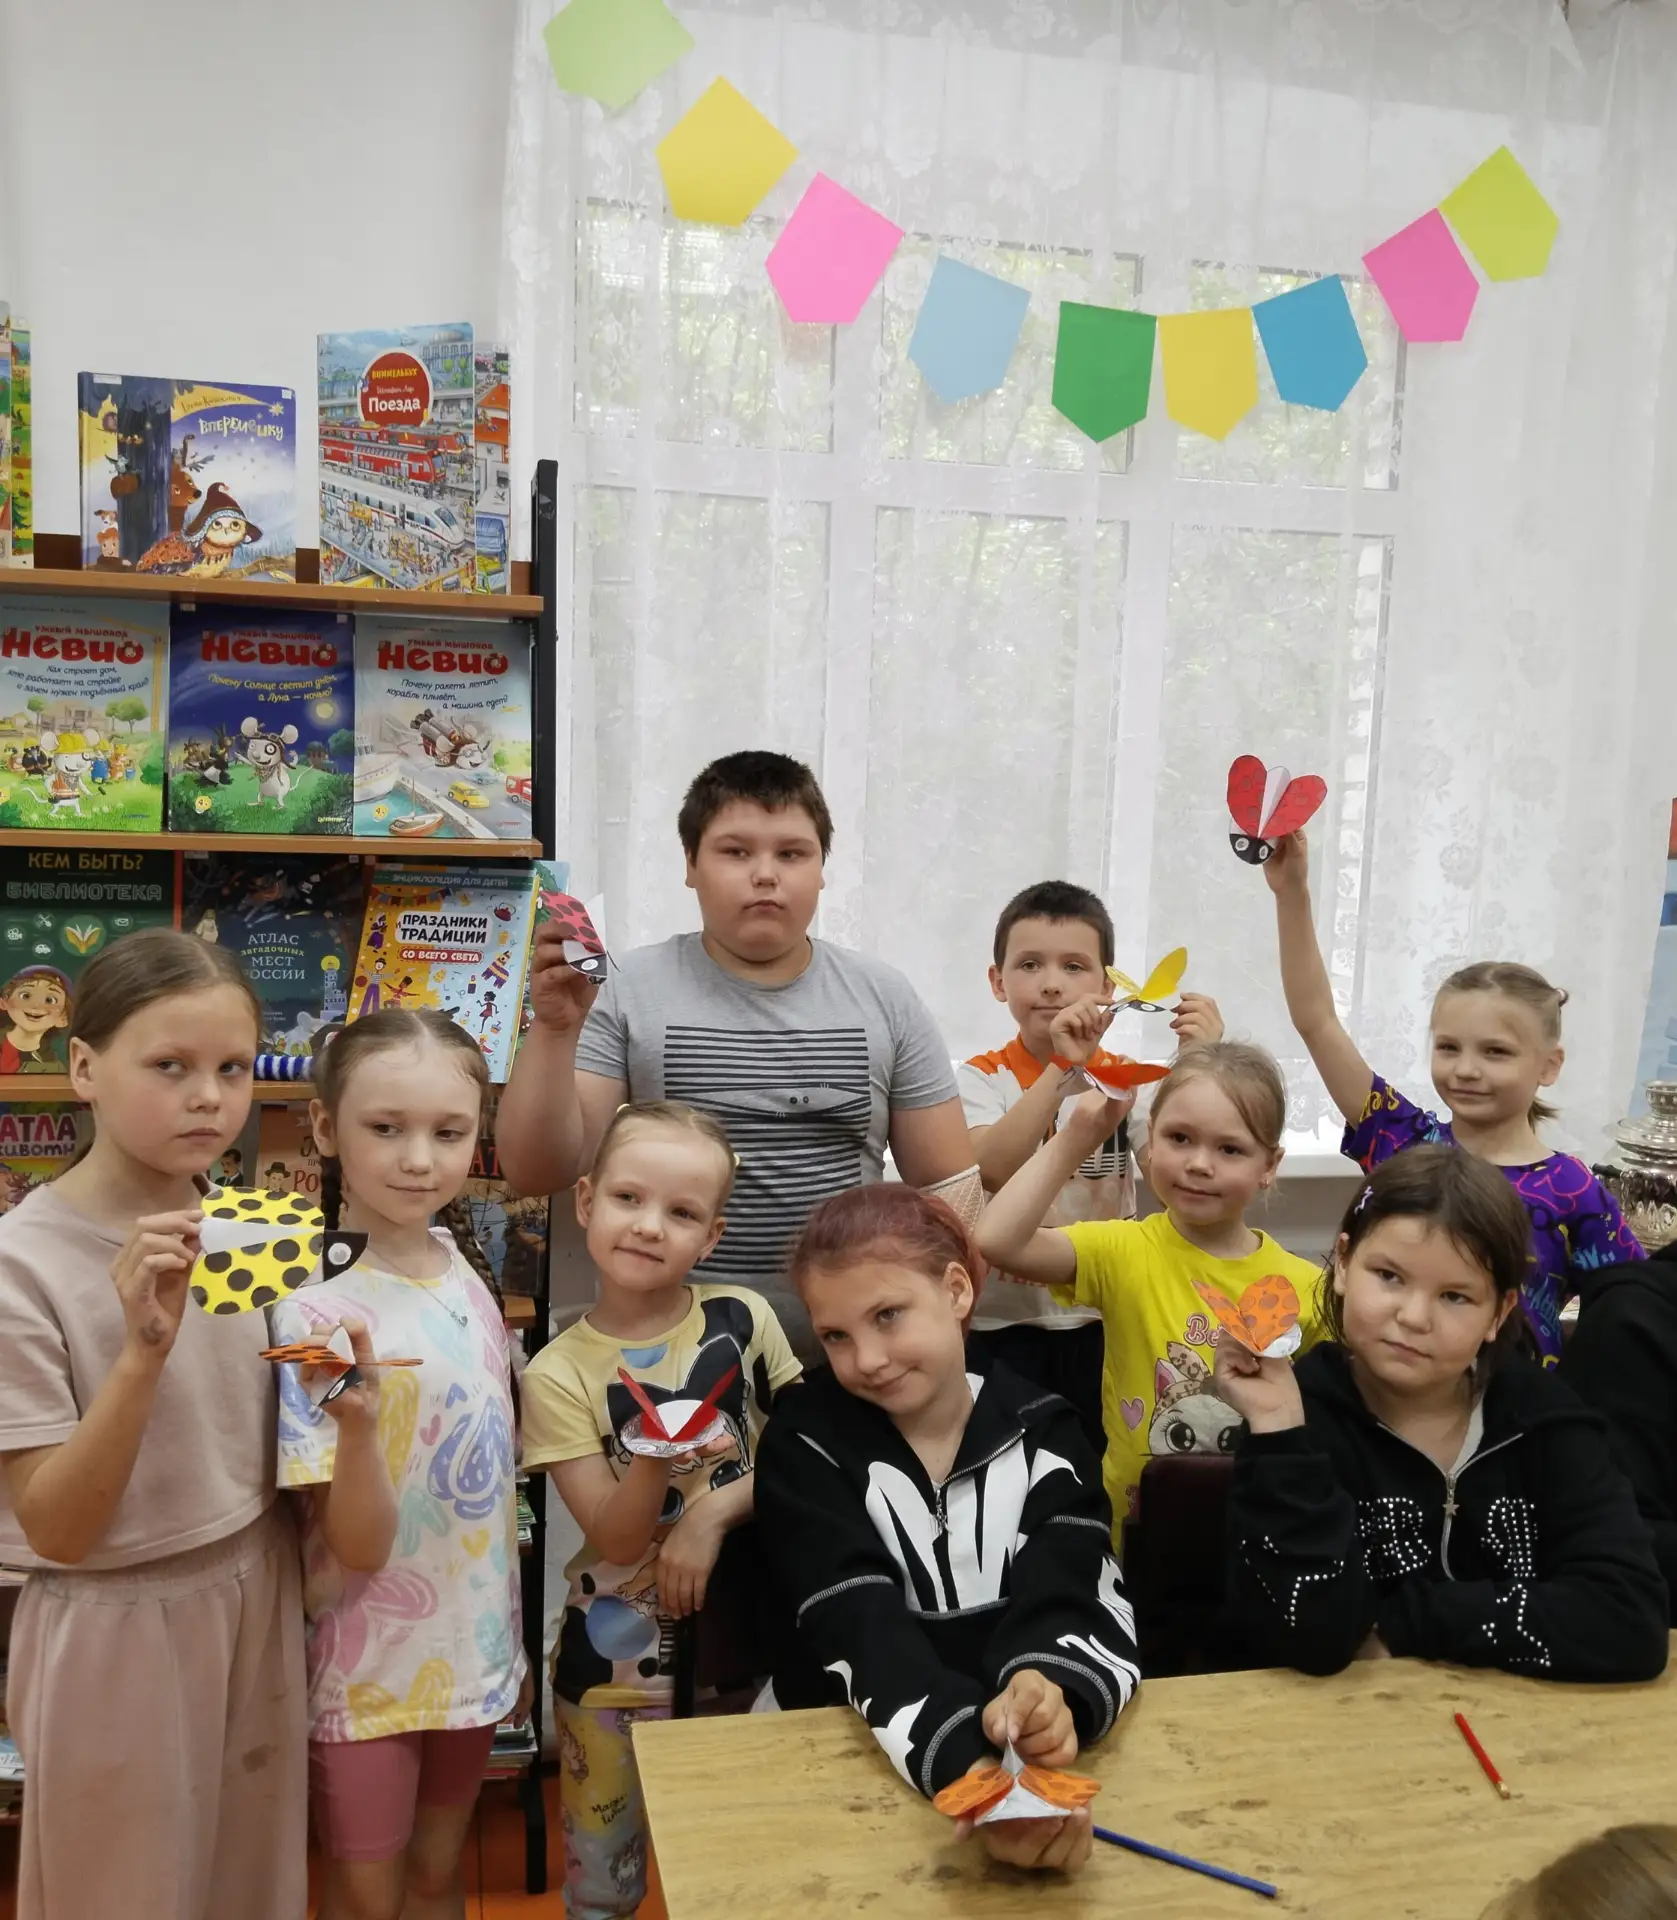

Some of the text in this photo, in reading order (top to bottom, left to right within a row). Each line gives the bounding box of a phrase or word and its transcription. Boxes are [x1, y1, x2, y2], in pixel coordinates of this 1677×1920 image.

[368, 397, 421, 413] Поезда
[46, 665, 61, 674] Как
[25, 672, 72, 687] работает
[74, 679, 84, 687] на
[87, 676, 122, 687] стройке
[208, 673, 242, 689] Почему
[244, 680, 276, 691] Солнце
[279, 680, 313, 690] светит
[401, 678, 433, 691] Почему
[434, 681, 466, 692] ракета
[24, 685, 48, 695] зачем
[51, 688, 77, 698] нужен
[128, 677, 149, 692] кран?
[267, 693, 290, 703] Луна
[304, 687, 333, 700] ночью?
[386, 687, 420, 701] корабль
[451, 701, 484, 710] машина
[486, 694, 509, 710] едет?
[28, 852, 144, 870] КЕМ БЫТЬ?
[391, 874, 509, 887] ЭНЦИКЛОПЕДИЯ ДЛЯ ДЕТЕЙ
[6, 881, 162, 901] БИБЛИОТЕКА
[402, 914, 488, 929] ПРАЗДНИКИ
[248, 933, 300, 945] АТЛАС
[401, 928, 487, 944] ТРАДИЦИИ
[251, 956, 295, 967] МЕСТ
[402, 950, 480, 962] СО ВСЕГО СВЕТА
[246, 969, 305, 980] ОССИИ
[0, 1114, 76, 1142] АТЛА
